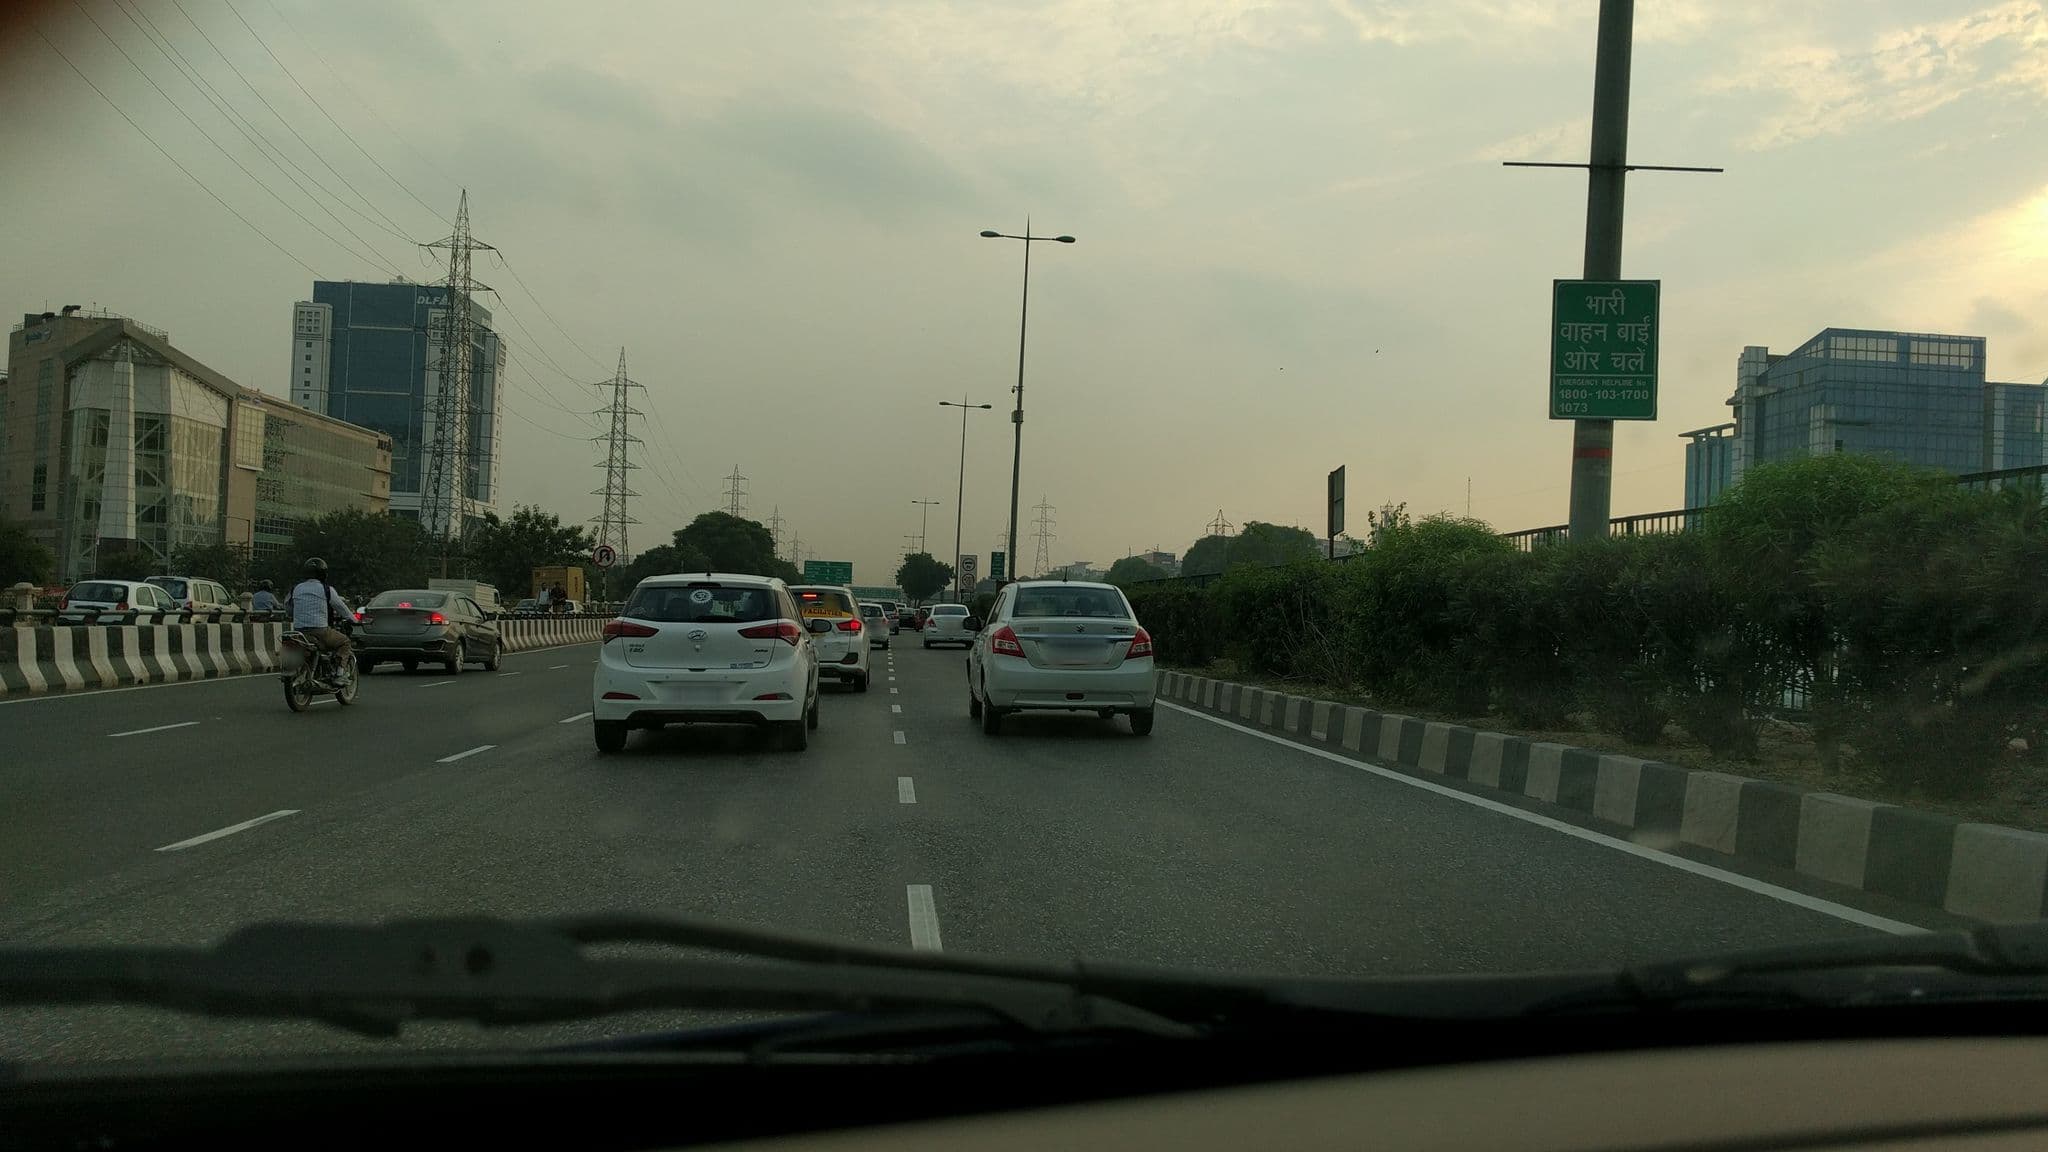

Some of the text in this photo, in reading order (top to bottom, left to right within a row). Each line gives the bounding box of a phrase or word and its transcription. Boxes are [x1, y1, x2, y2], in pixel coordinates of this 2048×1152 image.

[416, 295, 441, 305] DLF
[1585, 288, 1626, 315] भारी
[1560, 322, 1608, 343] वाहन
[1563, 346, 1646, 371] ओर चलें
[1559, 378, 1598, 386] EMERGENCY
[1602, 379, 1633, 387] HELPLINE
[1559, 402, 1588, 413] 1073
